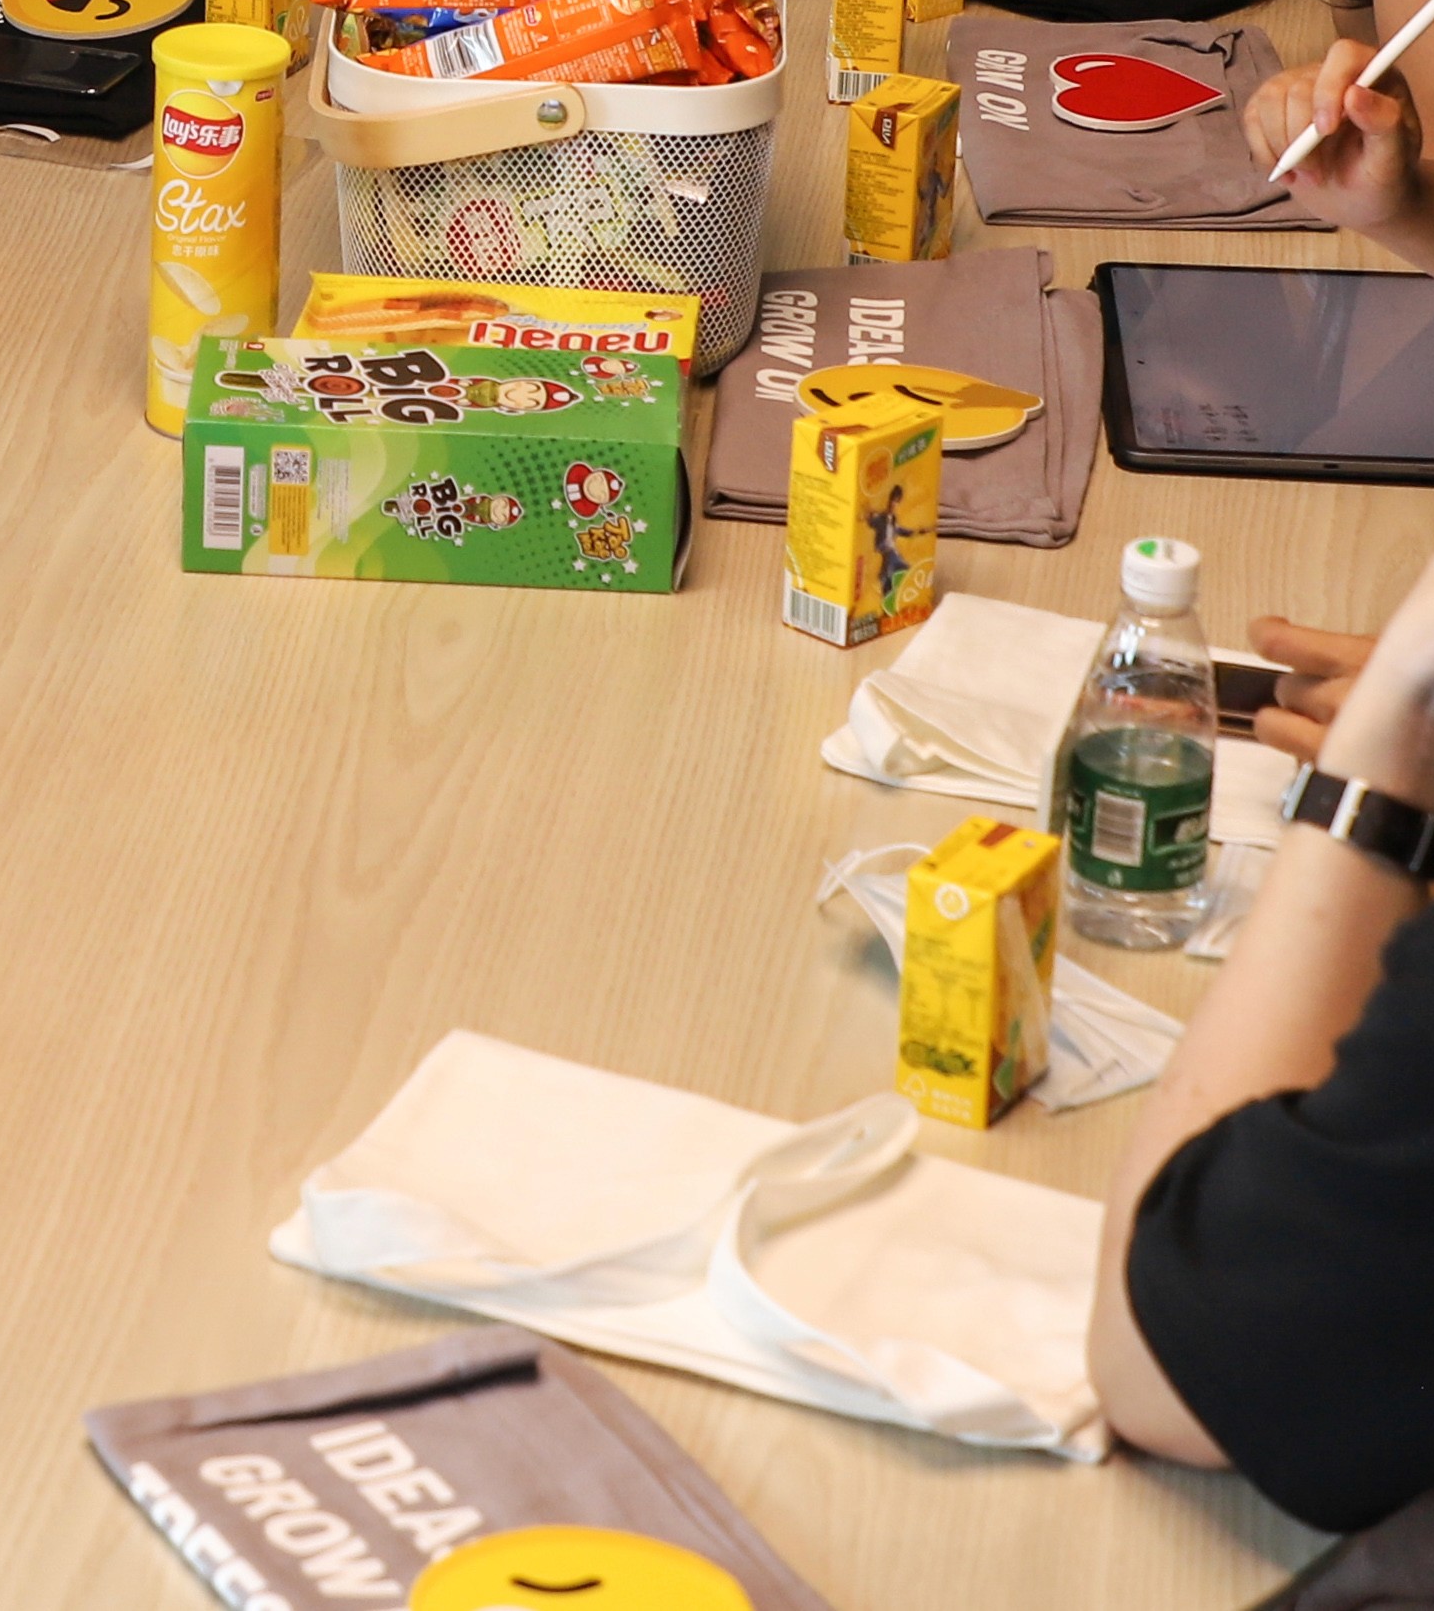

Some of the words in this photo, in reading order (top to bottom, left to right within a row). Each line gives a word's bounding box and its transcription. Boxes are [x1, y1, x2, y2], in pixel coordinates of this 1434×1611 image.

[163, 112, 199, 145] Lay's
[197, 124, 241, 148] 乐事
[155, 179, 246, 234] Stax
[760, 290, 818, 369] GROW
[304, 354, 373, 424] ROLL
[411, 482, 434, 538] ROLL
[199, 1453, 401, 1598] GROW
[310, 1419, 481, 1562] IDEA
